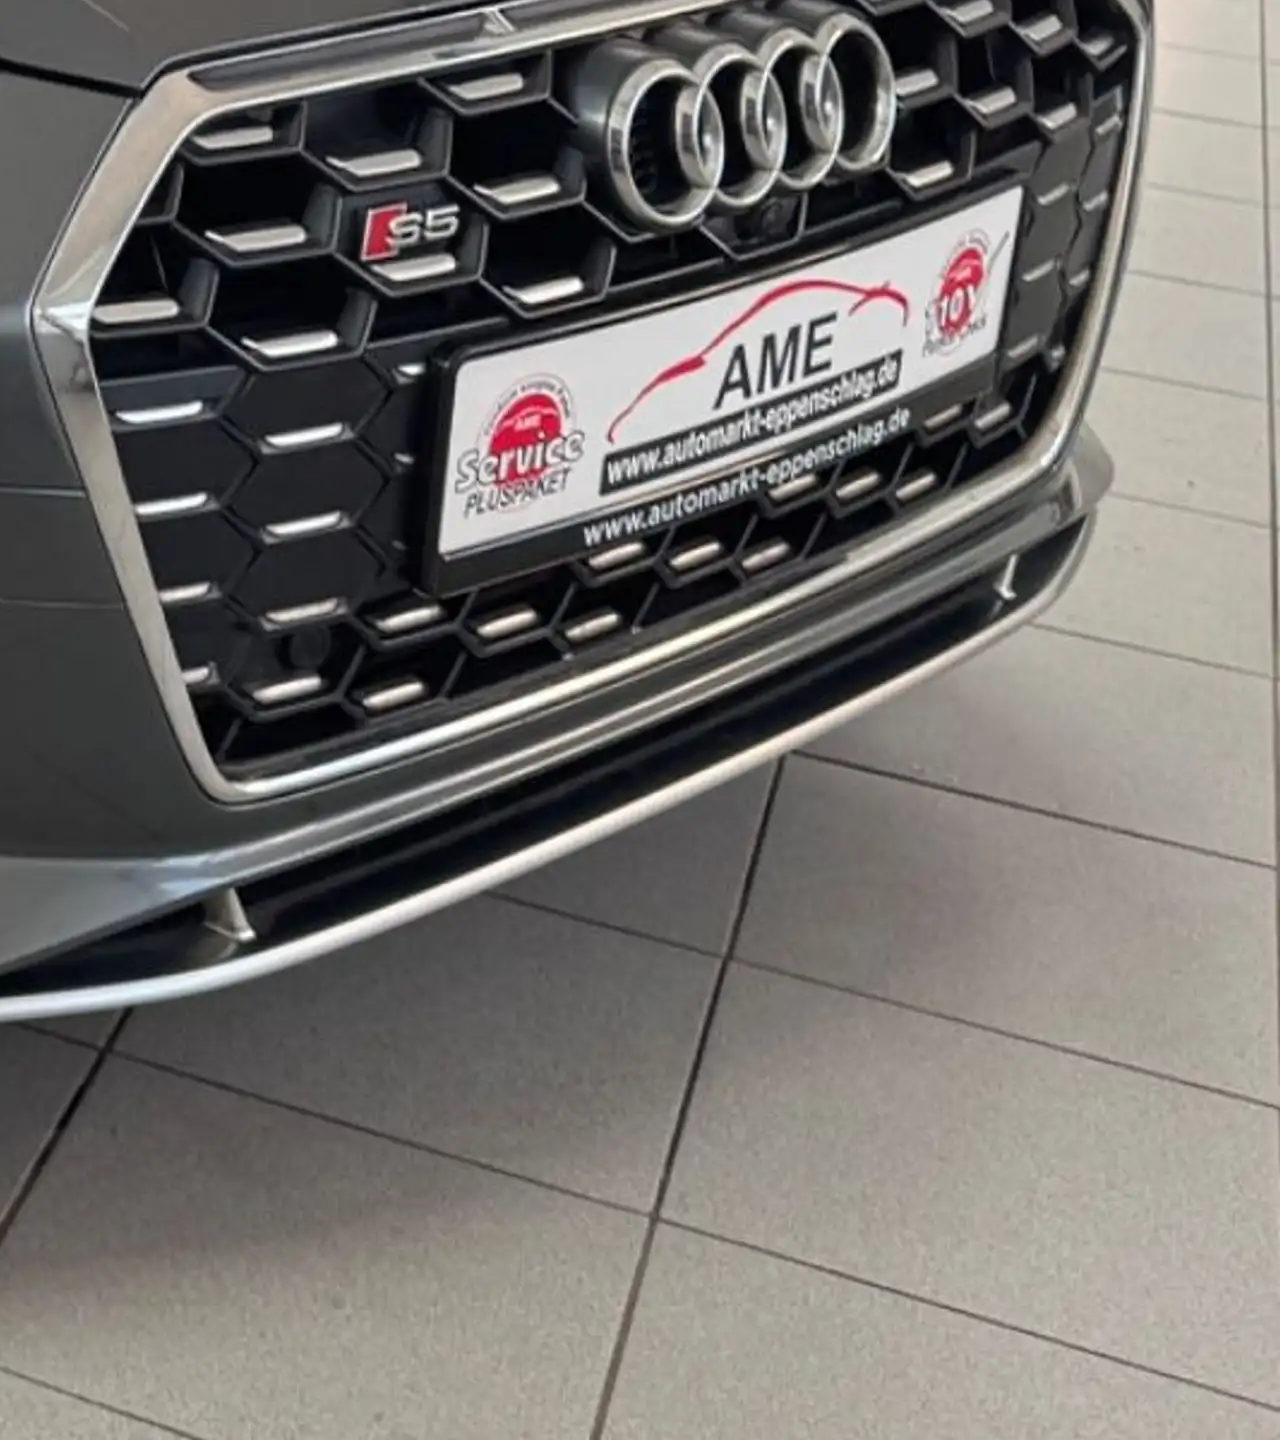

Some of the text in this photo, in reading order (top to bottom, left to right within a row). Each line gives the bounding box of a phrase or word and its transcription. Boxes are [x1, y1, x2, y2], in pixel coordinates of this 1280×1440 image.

[384, 202, 460, 248] S5
[712, 311, 838, 410] AME
[454, 429, 586, 495] Service
[606, 357, 901, 486] www.automarkt-eppenschlag.de
[582, 406, 912, 548] www.automarkt-eppenschlag.de
